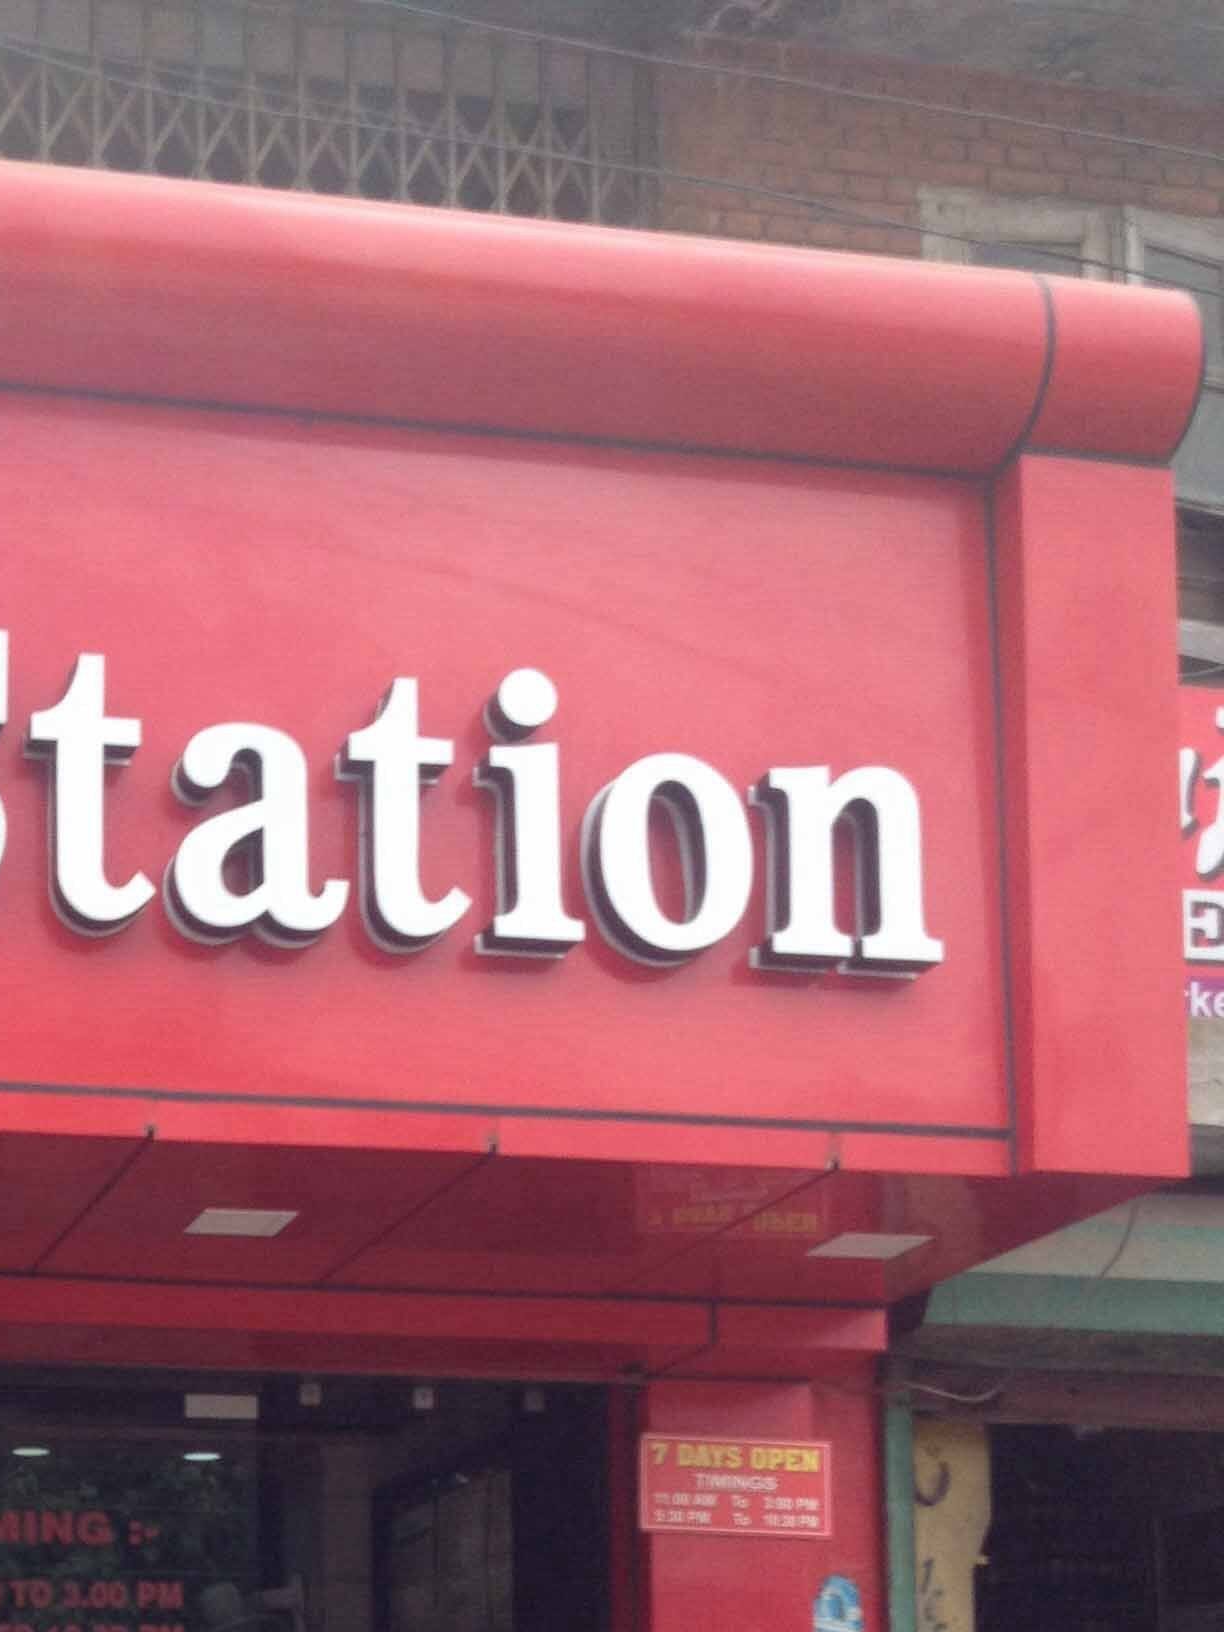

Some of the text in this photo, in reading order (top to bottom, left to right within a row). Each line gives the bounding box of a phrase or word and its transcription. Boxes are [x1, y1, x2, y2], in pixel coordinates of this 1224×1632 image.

[650, 1442, 820, 1472] 7 DAYS OPEN
[10, 1580, 52, 1609] TO
[62, 1582, 126, 1610] 3.00
[136, 1582, 184, 1610] PM
